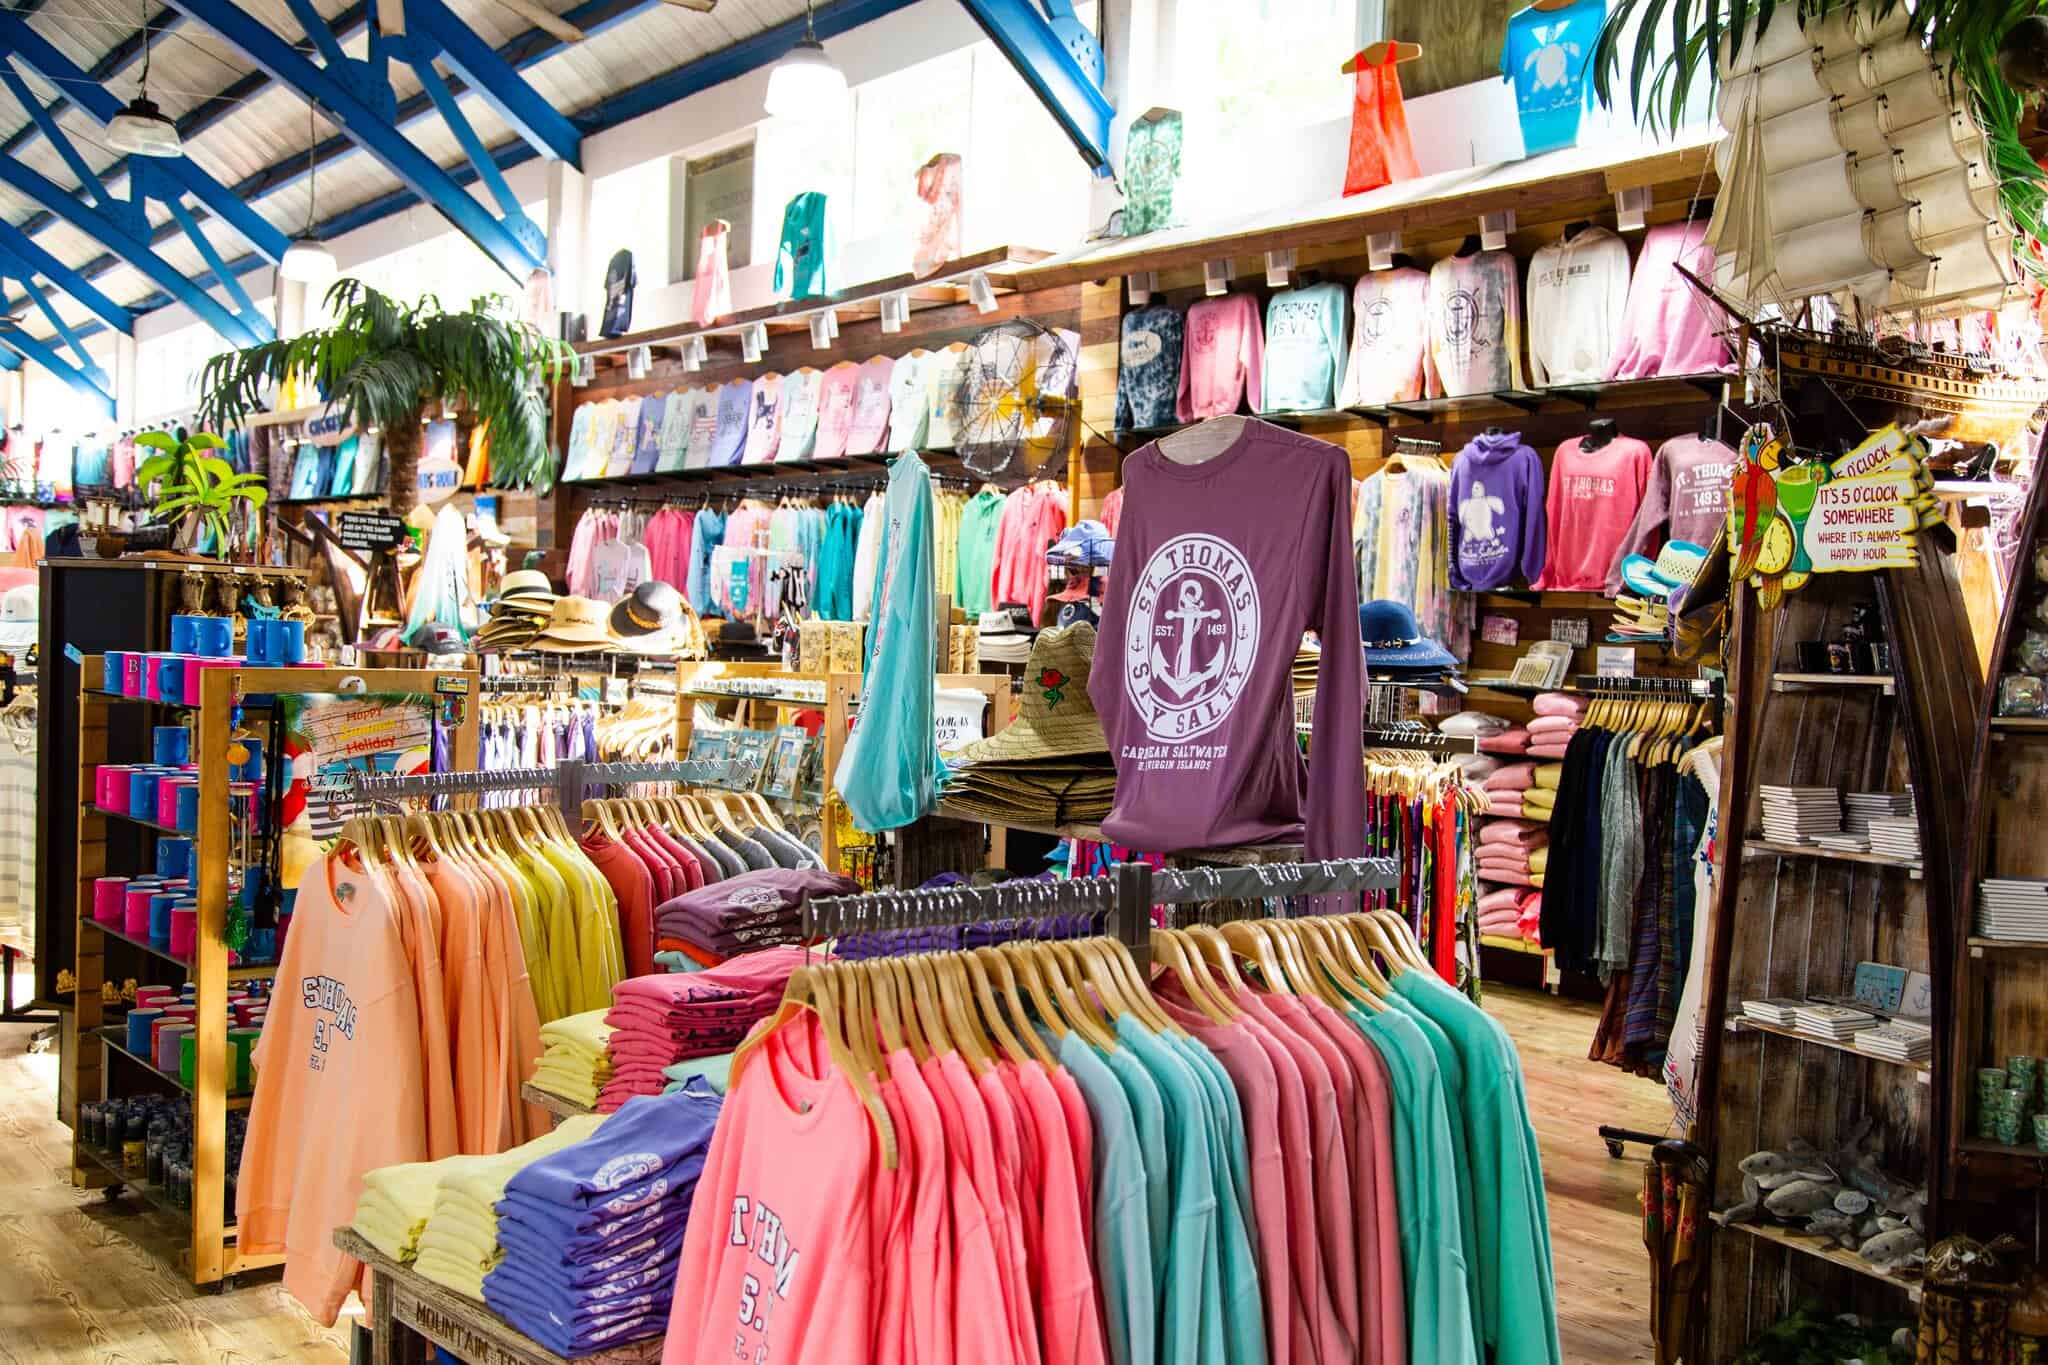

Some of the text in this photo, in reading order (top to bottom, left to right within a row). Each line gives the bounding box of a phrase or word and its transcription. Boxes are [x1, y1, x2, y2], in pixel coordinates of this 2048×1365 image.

[1820, 485, 1898, 505] IT'S 5 O'CLOCK
[1823, 508, 1895, 526] SOMEWHERE
[1818, 531, 1847, 545] WHERE
[1867, 530, 1901, 543] ALWAYS
[1830, 546, 1887, 561] HAPPY HOUR
[1166, 544, 1252, 612] THOMAS
[1154, 623, 1227, 638] EST. 1493
[346, 706, 382, 722] Happy
[346, 735, 396, 756] Holiday
[1177, 760, 1212, 770] ISLANDS
[415, 1300, 489, 1363] MOUNTAIN
